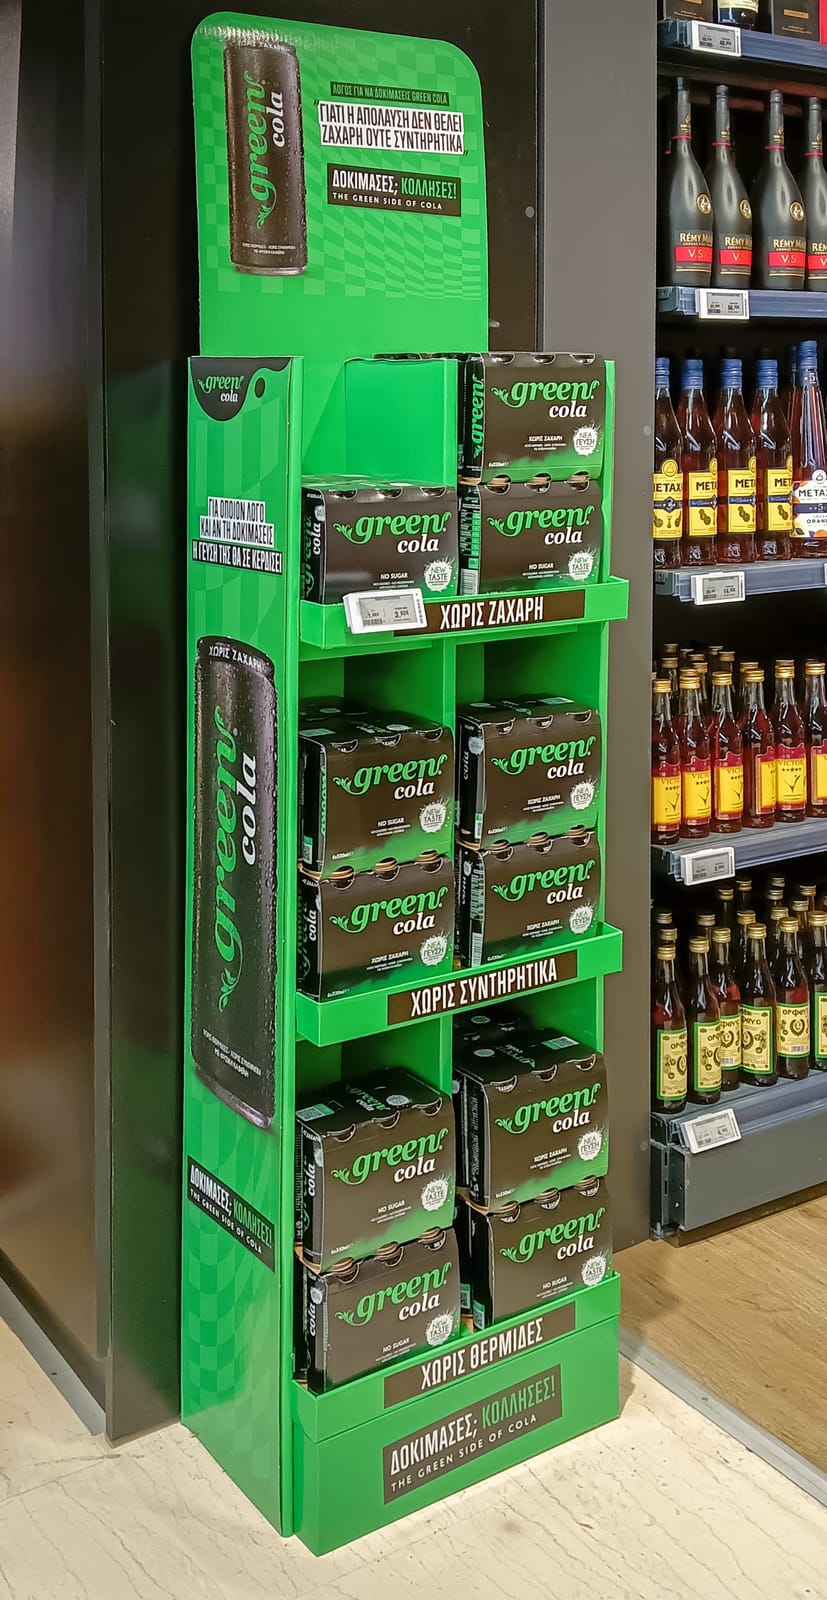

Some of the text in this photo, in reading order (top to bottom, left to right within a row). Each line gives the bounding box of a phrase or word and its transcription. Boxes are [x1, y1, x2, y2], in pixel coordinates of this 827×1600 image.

[333, 84, 447, 104] ΛΟΓΟΣ ΓΙΑ ΝΑ ΔΟΚΙΜΑΣΕΙΣ GREEN COLA
[266, 92, 285, 147] cola
[347, 105, 354, 124] Η
[357, 107, 409, 128] ΑΠΟΛΑΥΣΗ
[412, 111, 431, 130] ΔΕΝ
[434, 113, 462, 132] ΘΕΛΕΙ
[322, 125, 363, 145] ΖΑΧΑΡΗ
[366, 128, 391, 147] ΟΥΤΕ
[243, 71, 277, 228] green
[332, 170, 457, 199] ΔΟΚΙΜΑΣΕΣ; ΚΟΛΛΗΣΕΣ!
[333, 192, 348, 200] THE
[353, 194, 379, 204] GREEN
[383, 197, 402, 206] SIDE
[420, 201, 442, 210] COLA
[680, 232, 701, 242] RÉMY
[773, 238, 794, 248] RÉMY
[812, 242, 827, 252] RÉM
[197, 375, 244, 394] green
[491, 380, 600, 408] green
[220, 390, 238, 403] cola
[549, 400, 587, 418] cola
[576, 438, 595, 446] ΓΕΥΣΗ
[696, 481, 717, 491] MET
[735, 479, 755, 488] MET
[209, 498, 264, 523] ΓΙΑ ΟΠΟΙΟΝ ΛΟΓΟ
[486, 505, 595, 537] green
[201, 516, 273, 546] ΚΑΙ ΑΝ ΤΗ ΔΟΚΙΜΑΣΕΙΣ
[310, 522, 321, 555] cola
[333, 511, 452, 544] green
[544, 527, 583, 545] cola
[397, 534, 439, 553] cola
[192, 540, 282, 574] Η ΓΕΥΣΗ ΤΗΣ ΘΑ ΣΕ ΚΕΡΔΙΣΕΙ
[571, 563, 590, 572] TASTE
[574, 557, 588, 565] NEW
[428, 573, 448, 581] TASTE
[440, 602, 484, 630] ΧΩΡΙΣ
[488, 596, 544, 625] ΖΑΧΑΡΗ
[208, 645, 230, 659] ΧΩΡΙΣ
[491, 735, 596, 775] green
[332, 754, 448, 796] green
[547, 759, 584, 780] cola
[394, 777, 435, 800] cola
[236, 752, 256, 866] cola
[423, 814, 443, 823] TASTE
[426, 808, 441, 816] NEW
[378, 817, 405, 827] NO SUGAR
[214, 705, 243, 1013] green
[491, 859, 596, 902] green
[546, 884, 584, 905] cola
[328, 886, 449, 933] green
[575, 910, 588, 918] ΝΕΑ
[307, 909, 317, 941] cola
[393, 912, 435, 935] cola
[427, 940, 442, 949] ΝΕΑ
[411, 957, 558, 1017] ΧΩΡΙΣ ΣΥΝΤΗΡΗΤΙΚΑ
[495, 1082, 601, 1134] green
[552, 1109, 591, 1134] cola
[583, 1136, 596, 1145] ΝΕΑ
[330, 1127, 449, 1186] green
[306, 1163, 316, 1197] cola
[393, 1156, 436, 1184] cola
[424, 1191, 445, 1201] TASTE
[427, 1183, 443, 1193] NEW
[190, 1164, 272, 1248] ΔΟΚΙΜΑΣΕΣ; ΚΟΛΛΗΣΕΣ!
[378, 1200, 406, 1214] NO SUGAR
[190, 1188, 262, 1254] THE GREEN SIDE OF COLA
[499, 1207, 605, 1263] green
[556, 1235, 594, 1260] cola
[585, 1267, 602, 1278] TASTE
[587, 1263, 600, 1272] NEW
[334, 1261, 453, 1327] green
[543, 1282, 551, 1290] NO
[552, 1276, 567, 1287] SUGAR
[398, 1292, 441, 1321] cola
[308, 1302, 316, 1337] cola
[432, 1319, 447, 1329] NEW
[429, 1326, 450, 1337] TASTE
[392, 1338, 410, 1349] SUGAR
[421, 1351, 465, 1390] ΧΩΡΙΣ
[470, 1318, 543, 1369] ΘΕΡΜΙΔΕΣ
[390, 1374, 556, 1476] ΔΟΚΙΜΑΣΕΣ; ΚΟΛΛΗΣΕΣ!
[391, 1413, 537, 1492] THE GREEN SIDE OF COLA
